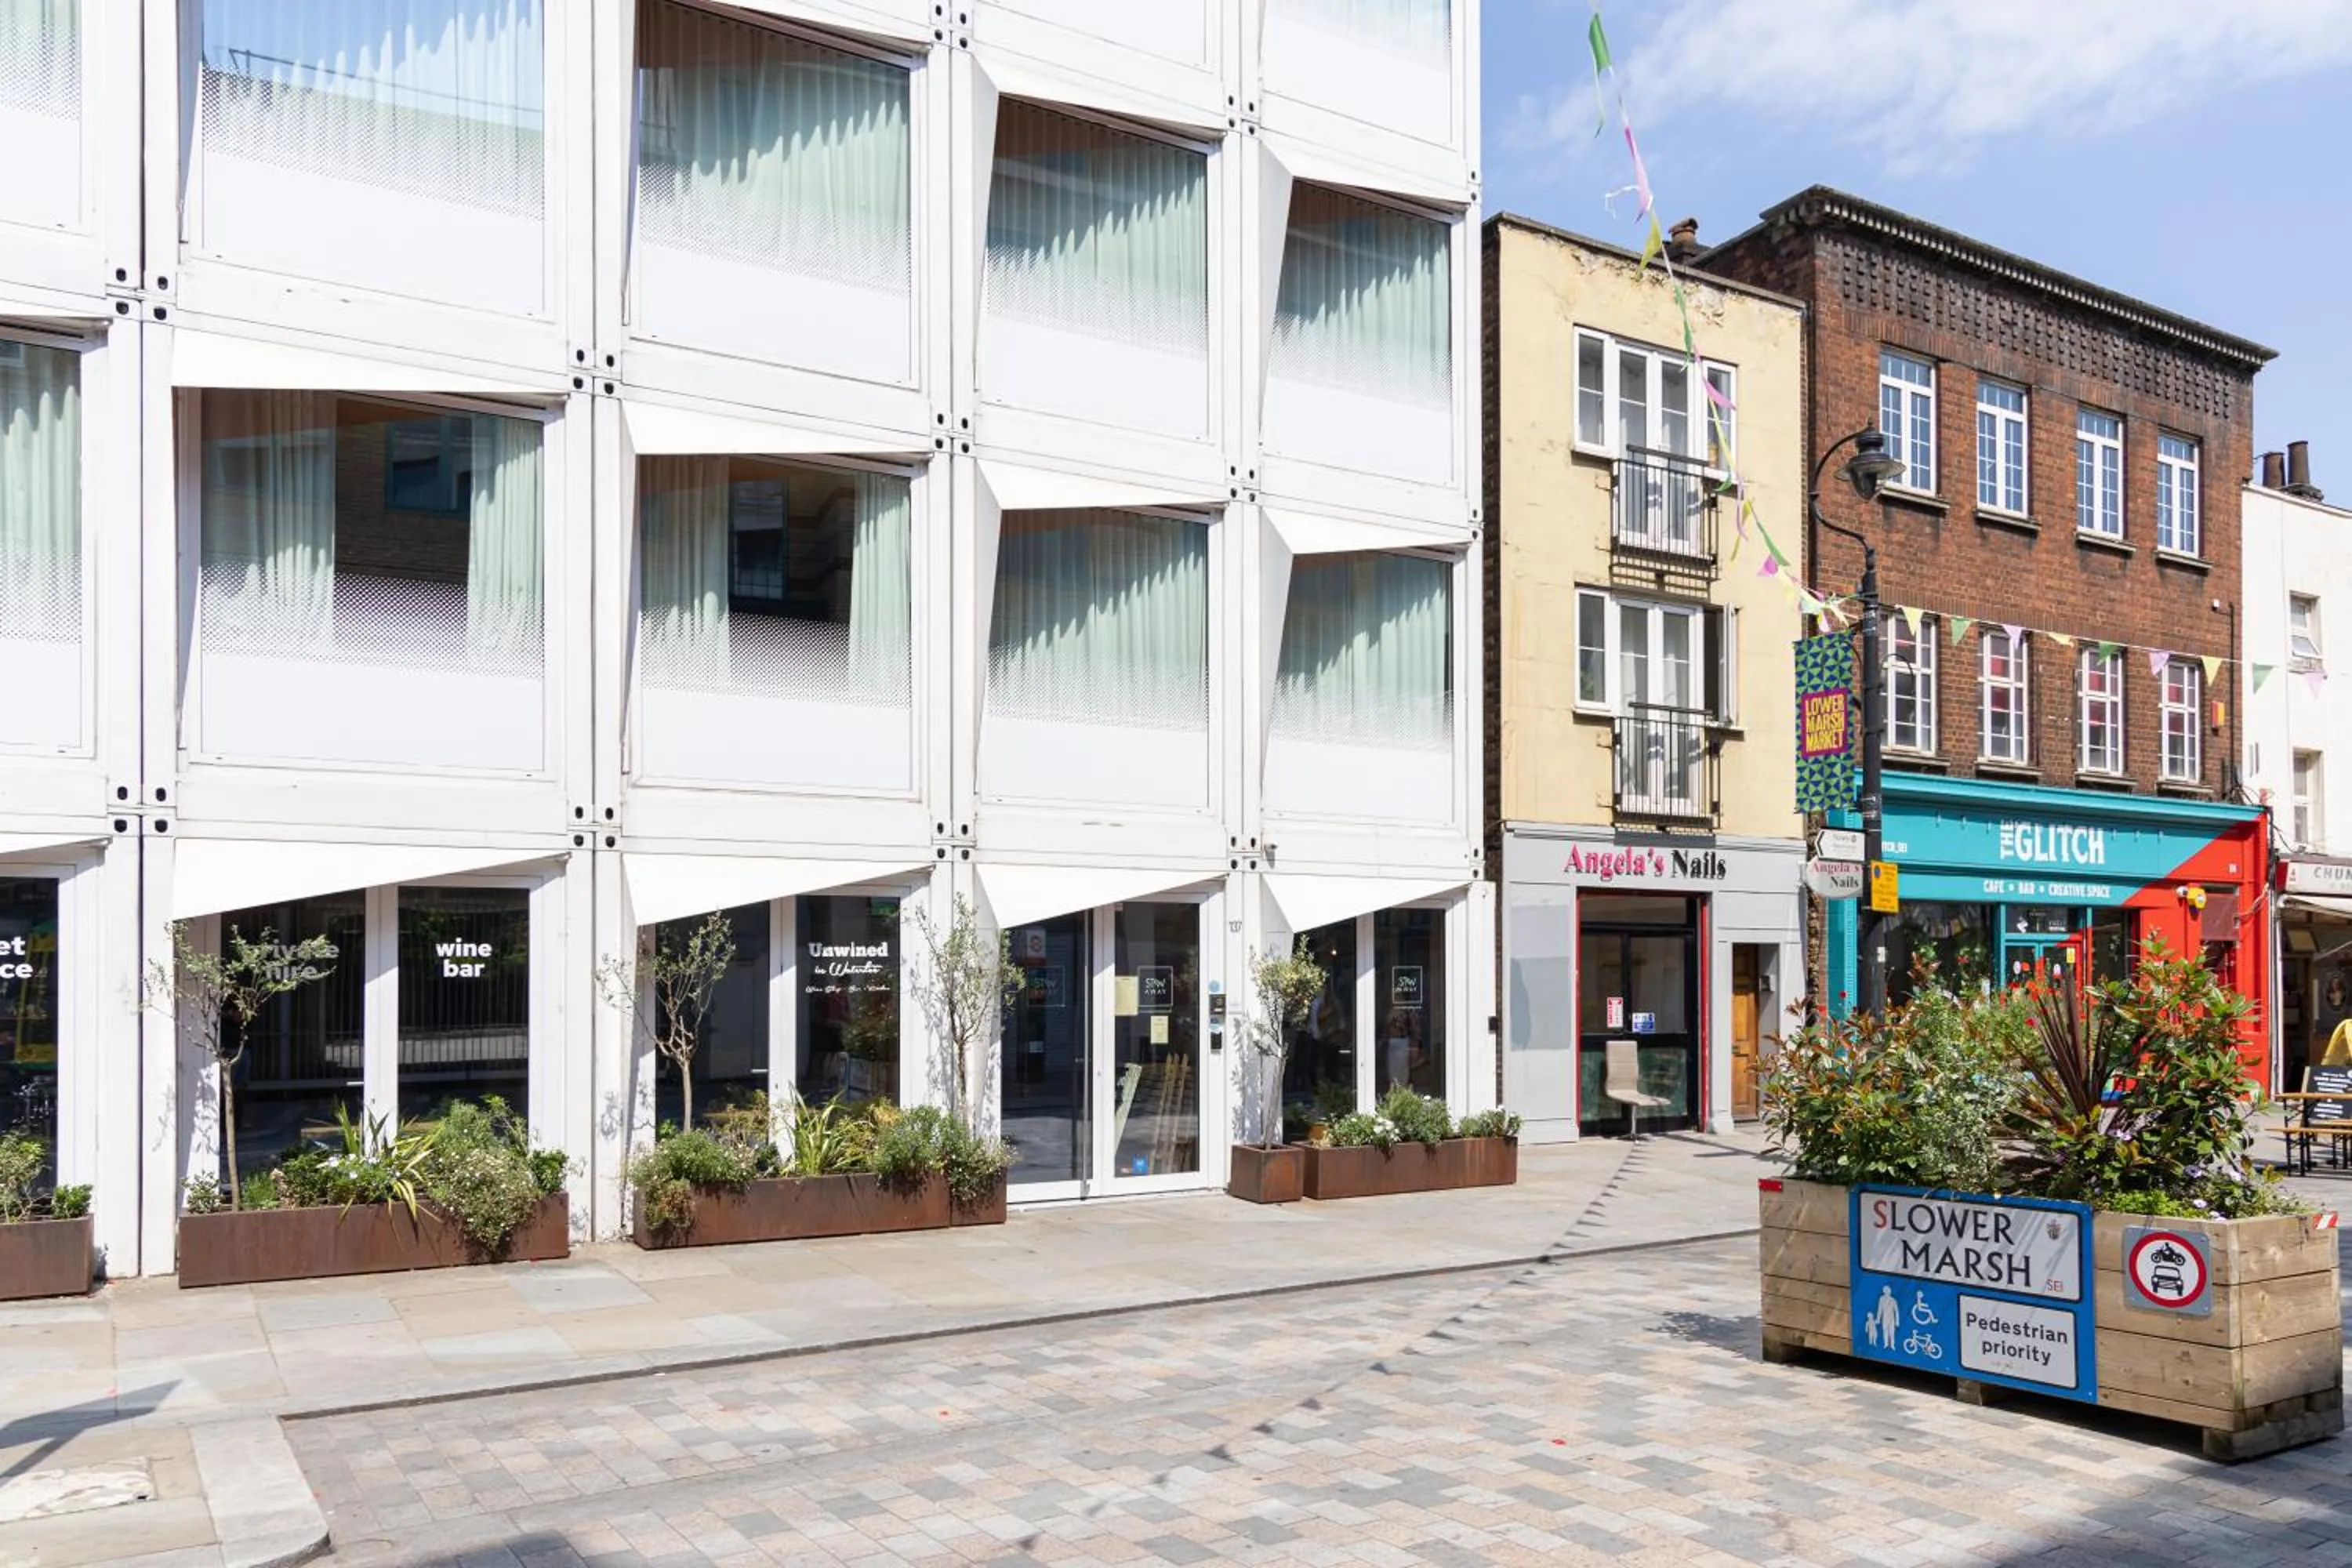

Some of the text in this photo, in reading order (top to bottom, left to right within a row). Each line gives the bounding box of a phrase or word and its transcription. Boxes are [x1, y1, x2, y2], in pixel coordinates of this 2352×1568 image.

[1806, 695, 1845, 715] LOWER
[1806, 710, 1845, 731] MARSH
[1806, 729, 1844, 753] MARKET
[2000, 820, 2106, 865] THE GLITCH
[1564, 841, 1727, 882] Angela's Nails
[1830, 876, 1860, 888] Nails
[1983, 879, 2111, 898] CAFE BAR CREATIVE SPACE
[435, 937, 493, 957] wine
[808, 941, 888, 957] Unwined
[443, 959, 485, 978] bar
[1873, 1200, 2015, 1246] SLOWER
[1901, 1240, 2031, 1287] MARSH
[2046, 1278, 2063, 1292] SE1
[1965, 1312, 2068, 1344] Pedestrian
[1981, 1339, 2052, 1367] priority
